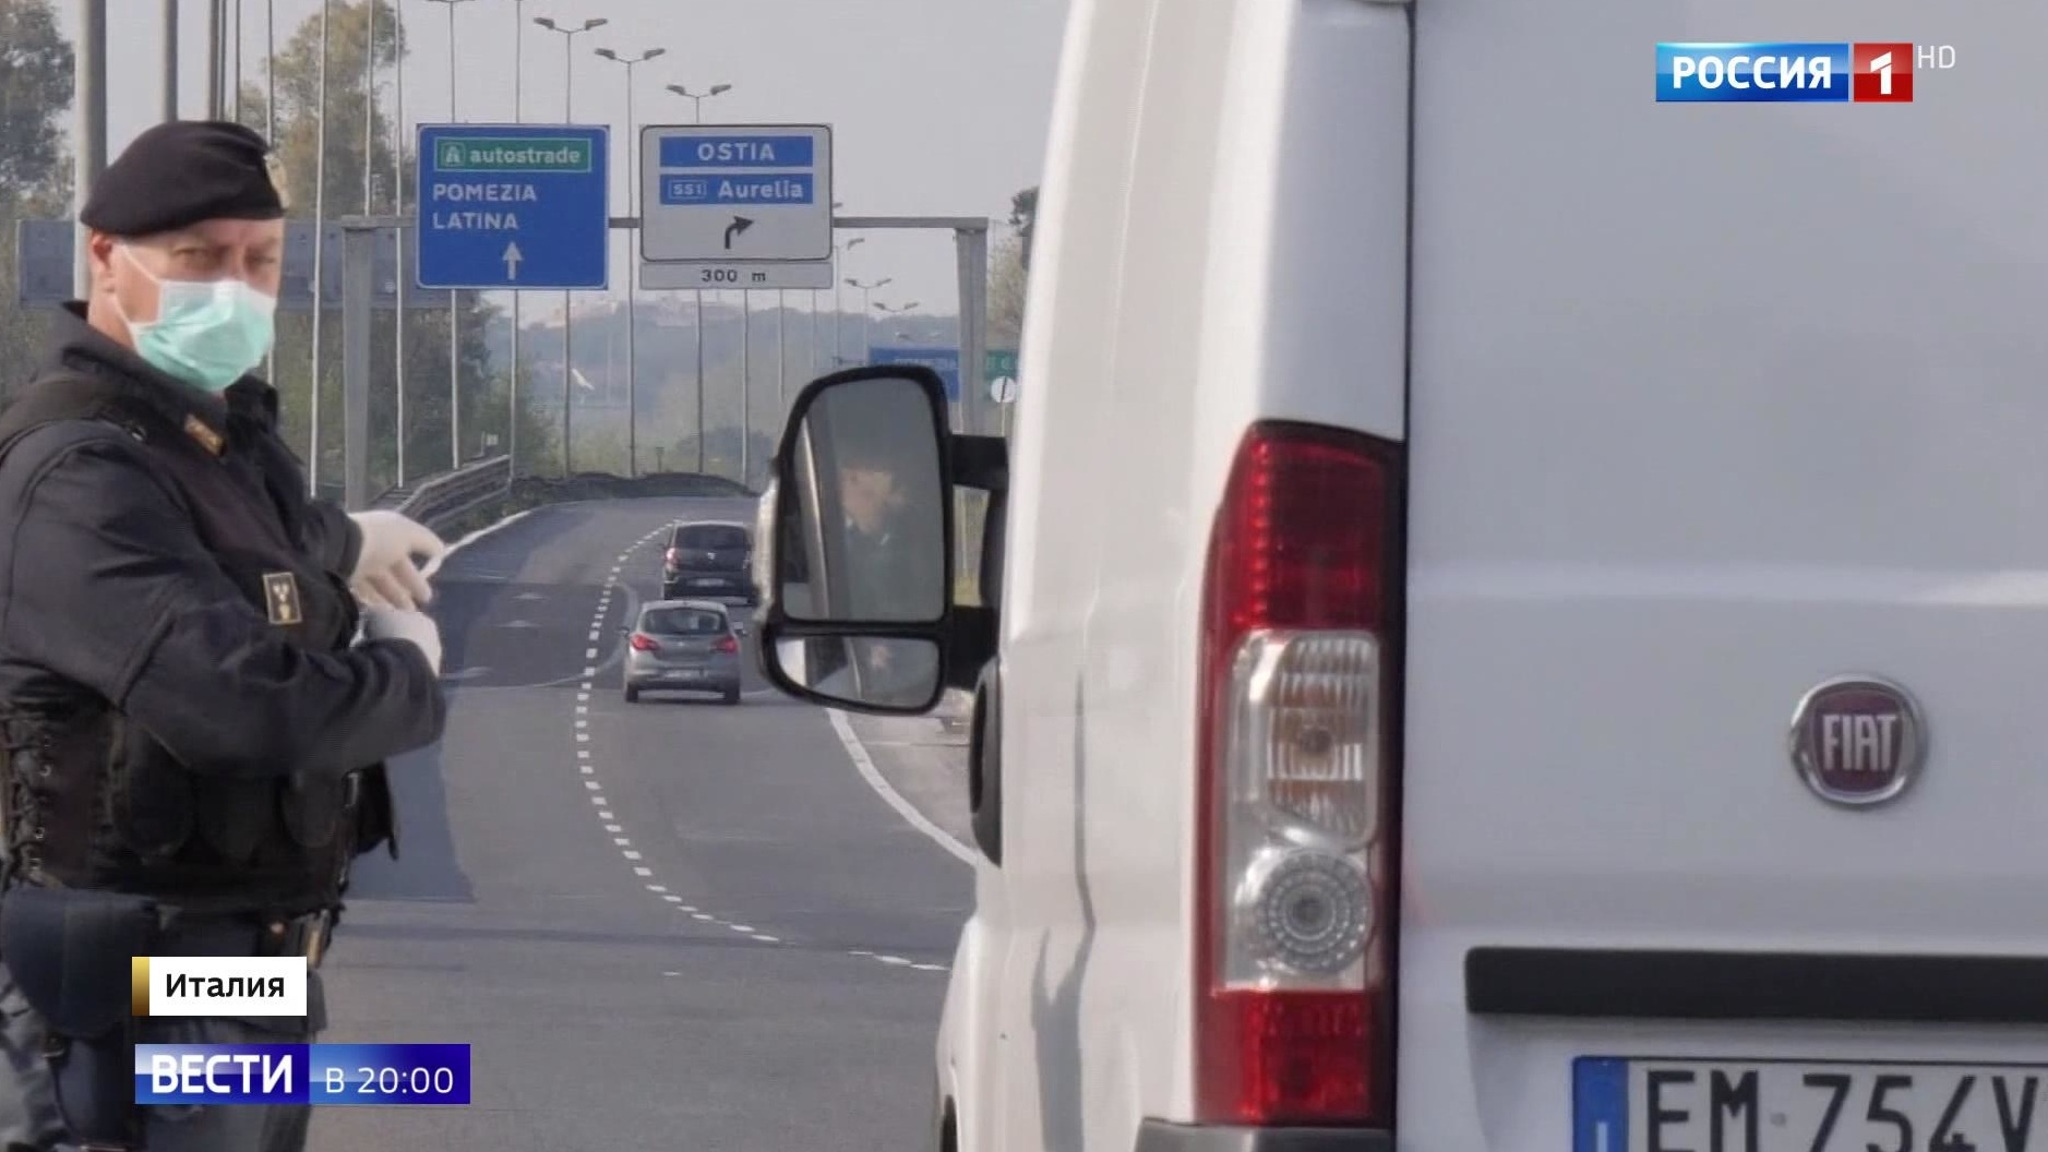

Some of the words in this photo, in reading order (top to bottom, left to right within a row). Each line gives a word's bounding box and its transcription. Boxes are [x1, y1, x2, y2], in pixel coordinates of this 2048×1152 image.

[469, 147, 581, 164] autostrade
[697, 142, 775, 161] OSTIA
[432, 183, 537, 202] POMEZIA
[718, 180, 804, 198] Aurelia
[432, 212, 519, 230] LATINA
[701, 269, 738, 282] 300
[751, 272, 766, 282] m
[1822, 713, 1898, 771] FIAT
[1647, 1070, 1759, 1152] EM
[1803, 1075, 2039, 1152] 754V
